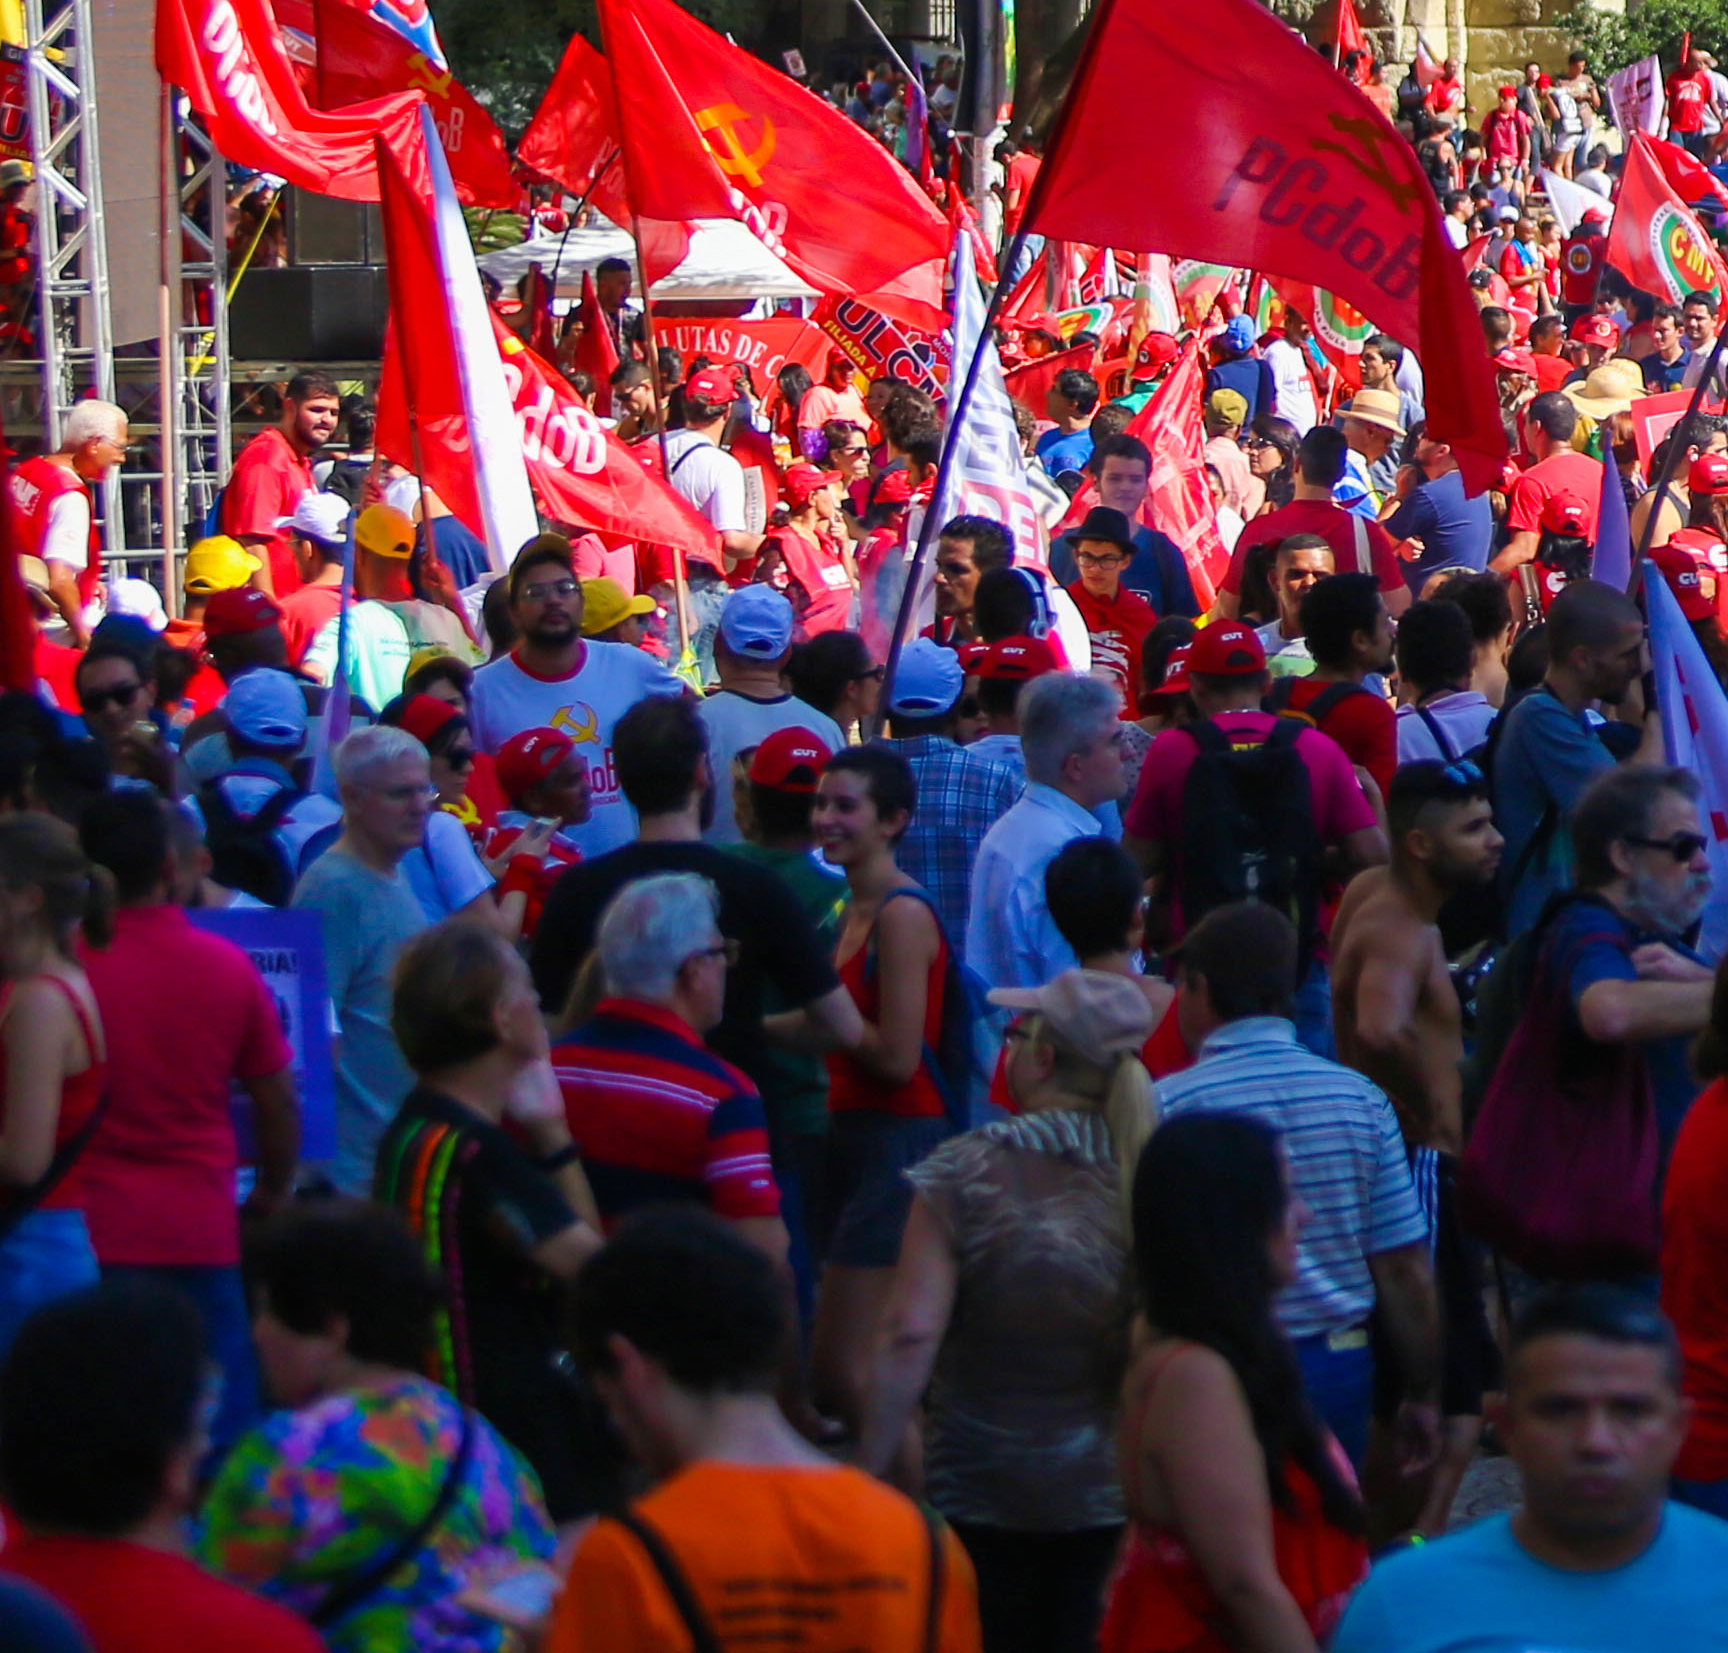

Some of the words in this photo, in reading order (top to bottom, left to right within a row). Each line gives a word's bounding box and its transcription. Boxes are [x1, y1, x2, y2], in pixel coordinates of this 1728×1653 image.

[1213, 135, 1423, 303] PCdoB
[671, 326, 733, 355] LUTAS
[735, 333, 769, 369] DE
[823, 318, 869, 368] FILIADA
[1221, 630, 1245, 641] CUT
[792, 749, 818, 758] CUT
